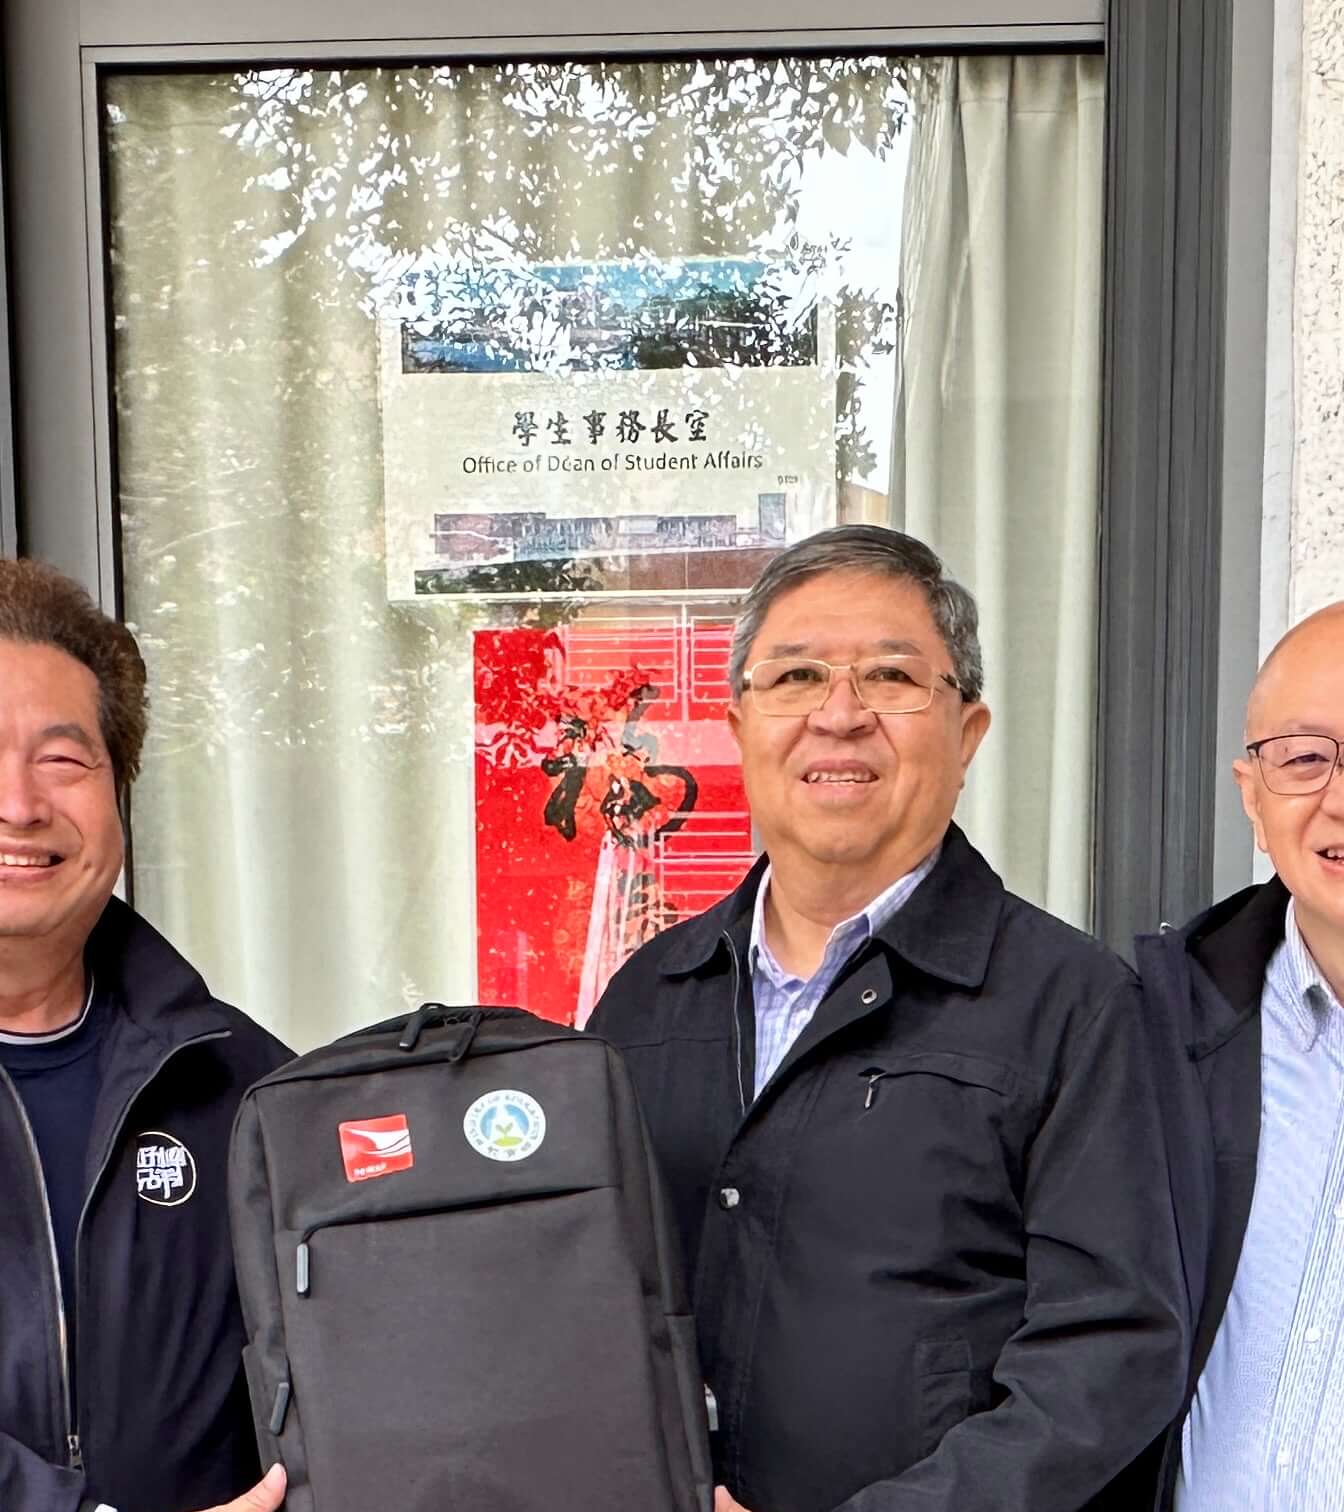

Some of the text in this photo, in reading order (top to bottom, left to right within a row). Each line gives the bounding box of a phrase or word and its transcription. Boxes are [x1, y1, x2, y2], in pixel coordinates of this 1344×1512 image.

[511, 408, 710, 447] 學生事務長室
[462, 449, 763, 474] Office of Dean of Student Affairs
